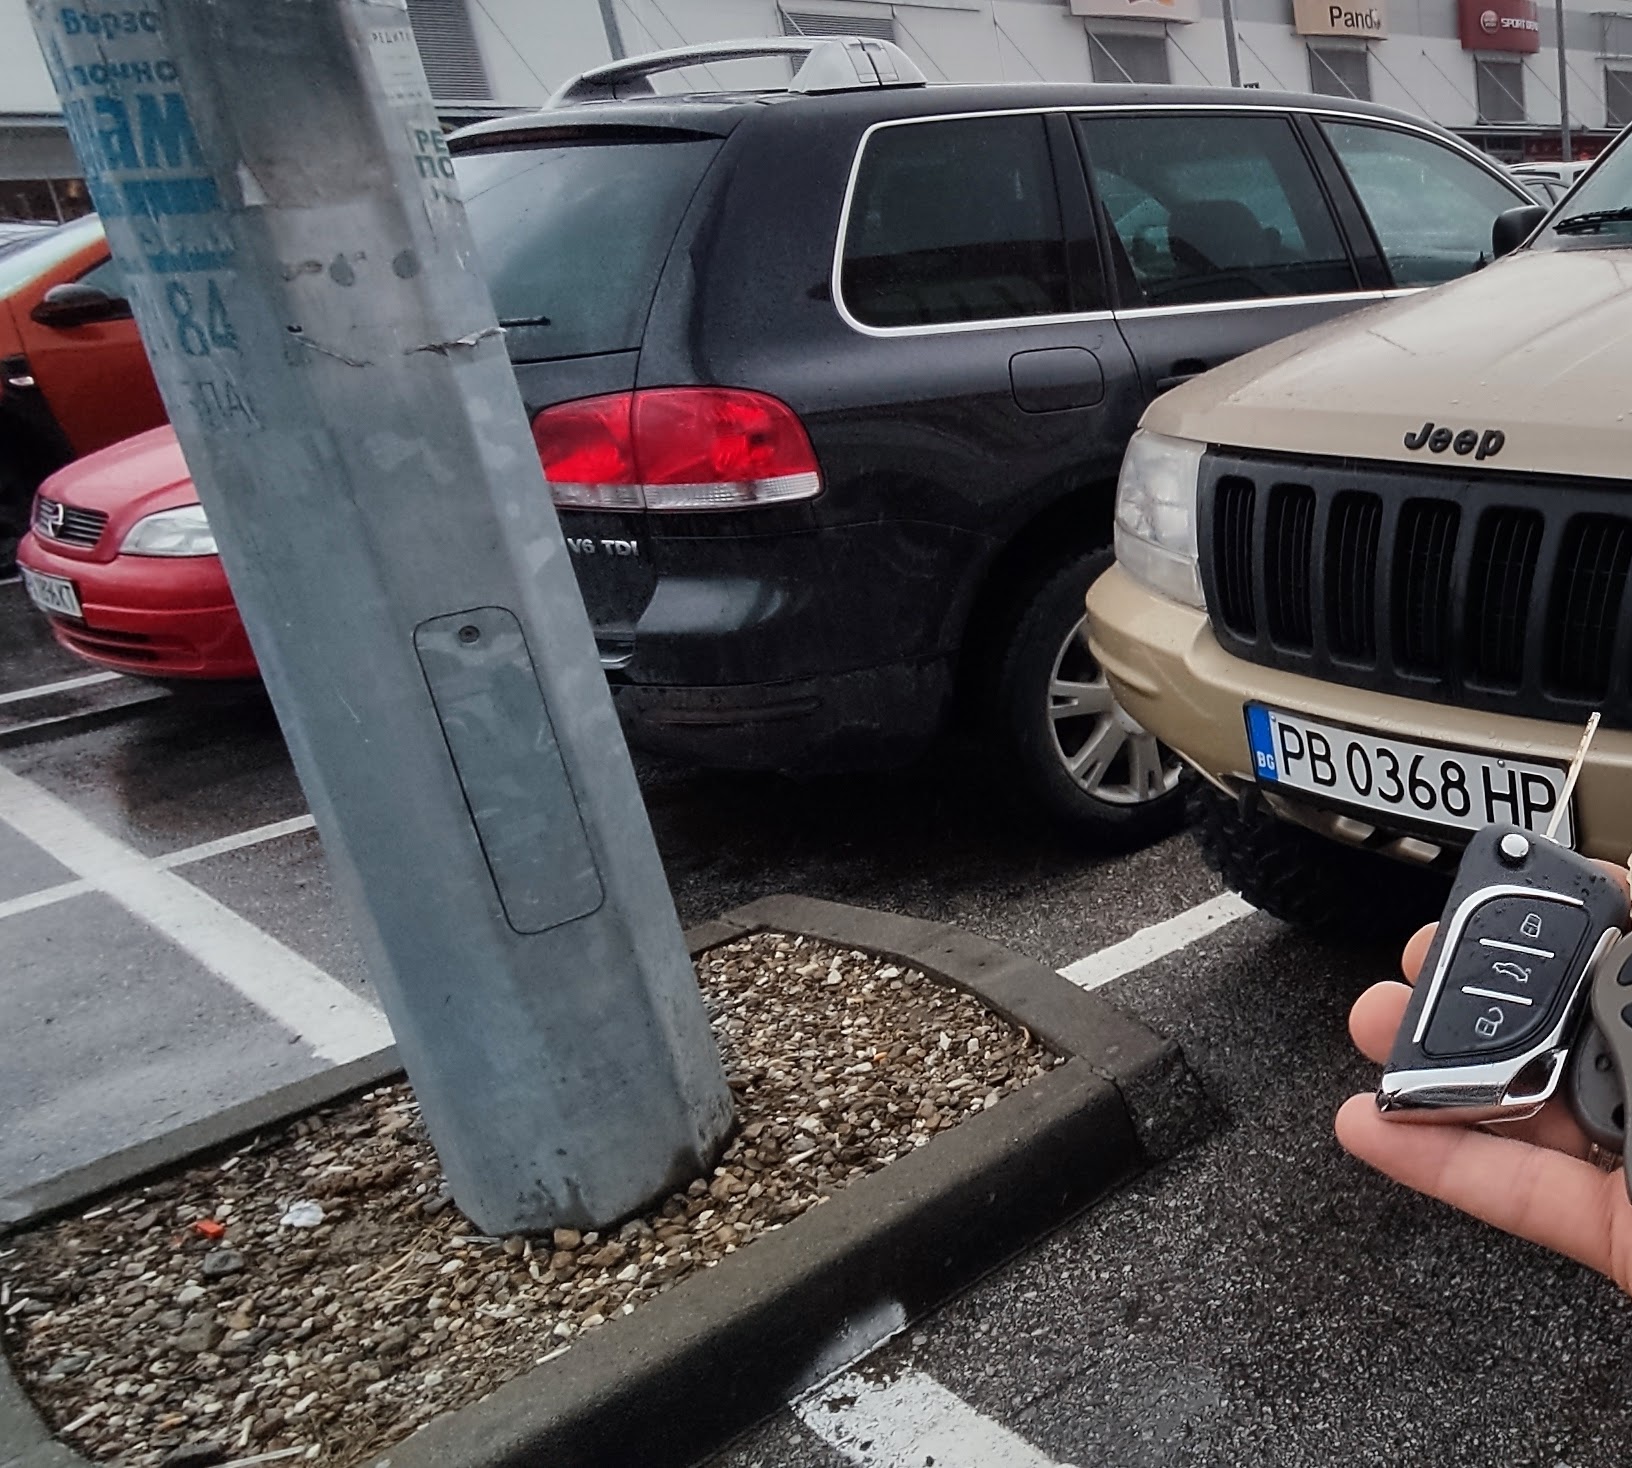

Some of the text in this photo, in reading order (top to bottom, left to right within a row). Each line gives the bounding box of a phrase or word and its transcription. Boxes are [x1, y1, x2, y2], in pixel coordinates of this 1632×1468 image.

[1501, 18, 1526, 29] SPORT
[1404, 422, 1505, 461] Jeep
[567, 538, 640, 556] V6 TDI
[1256, 750, 1276, 771] BG
[1277, 721, 1557, 832] PB 0368 HP
